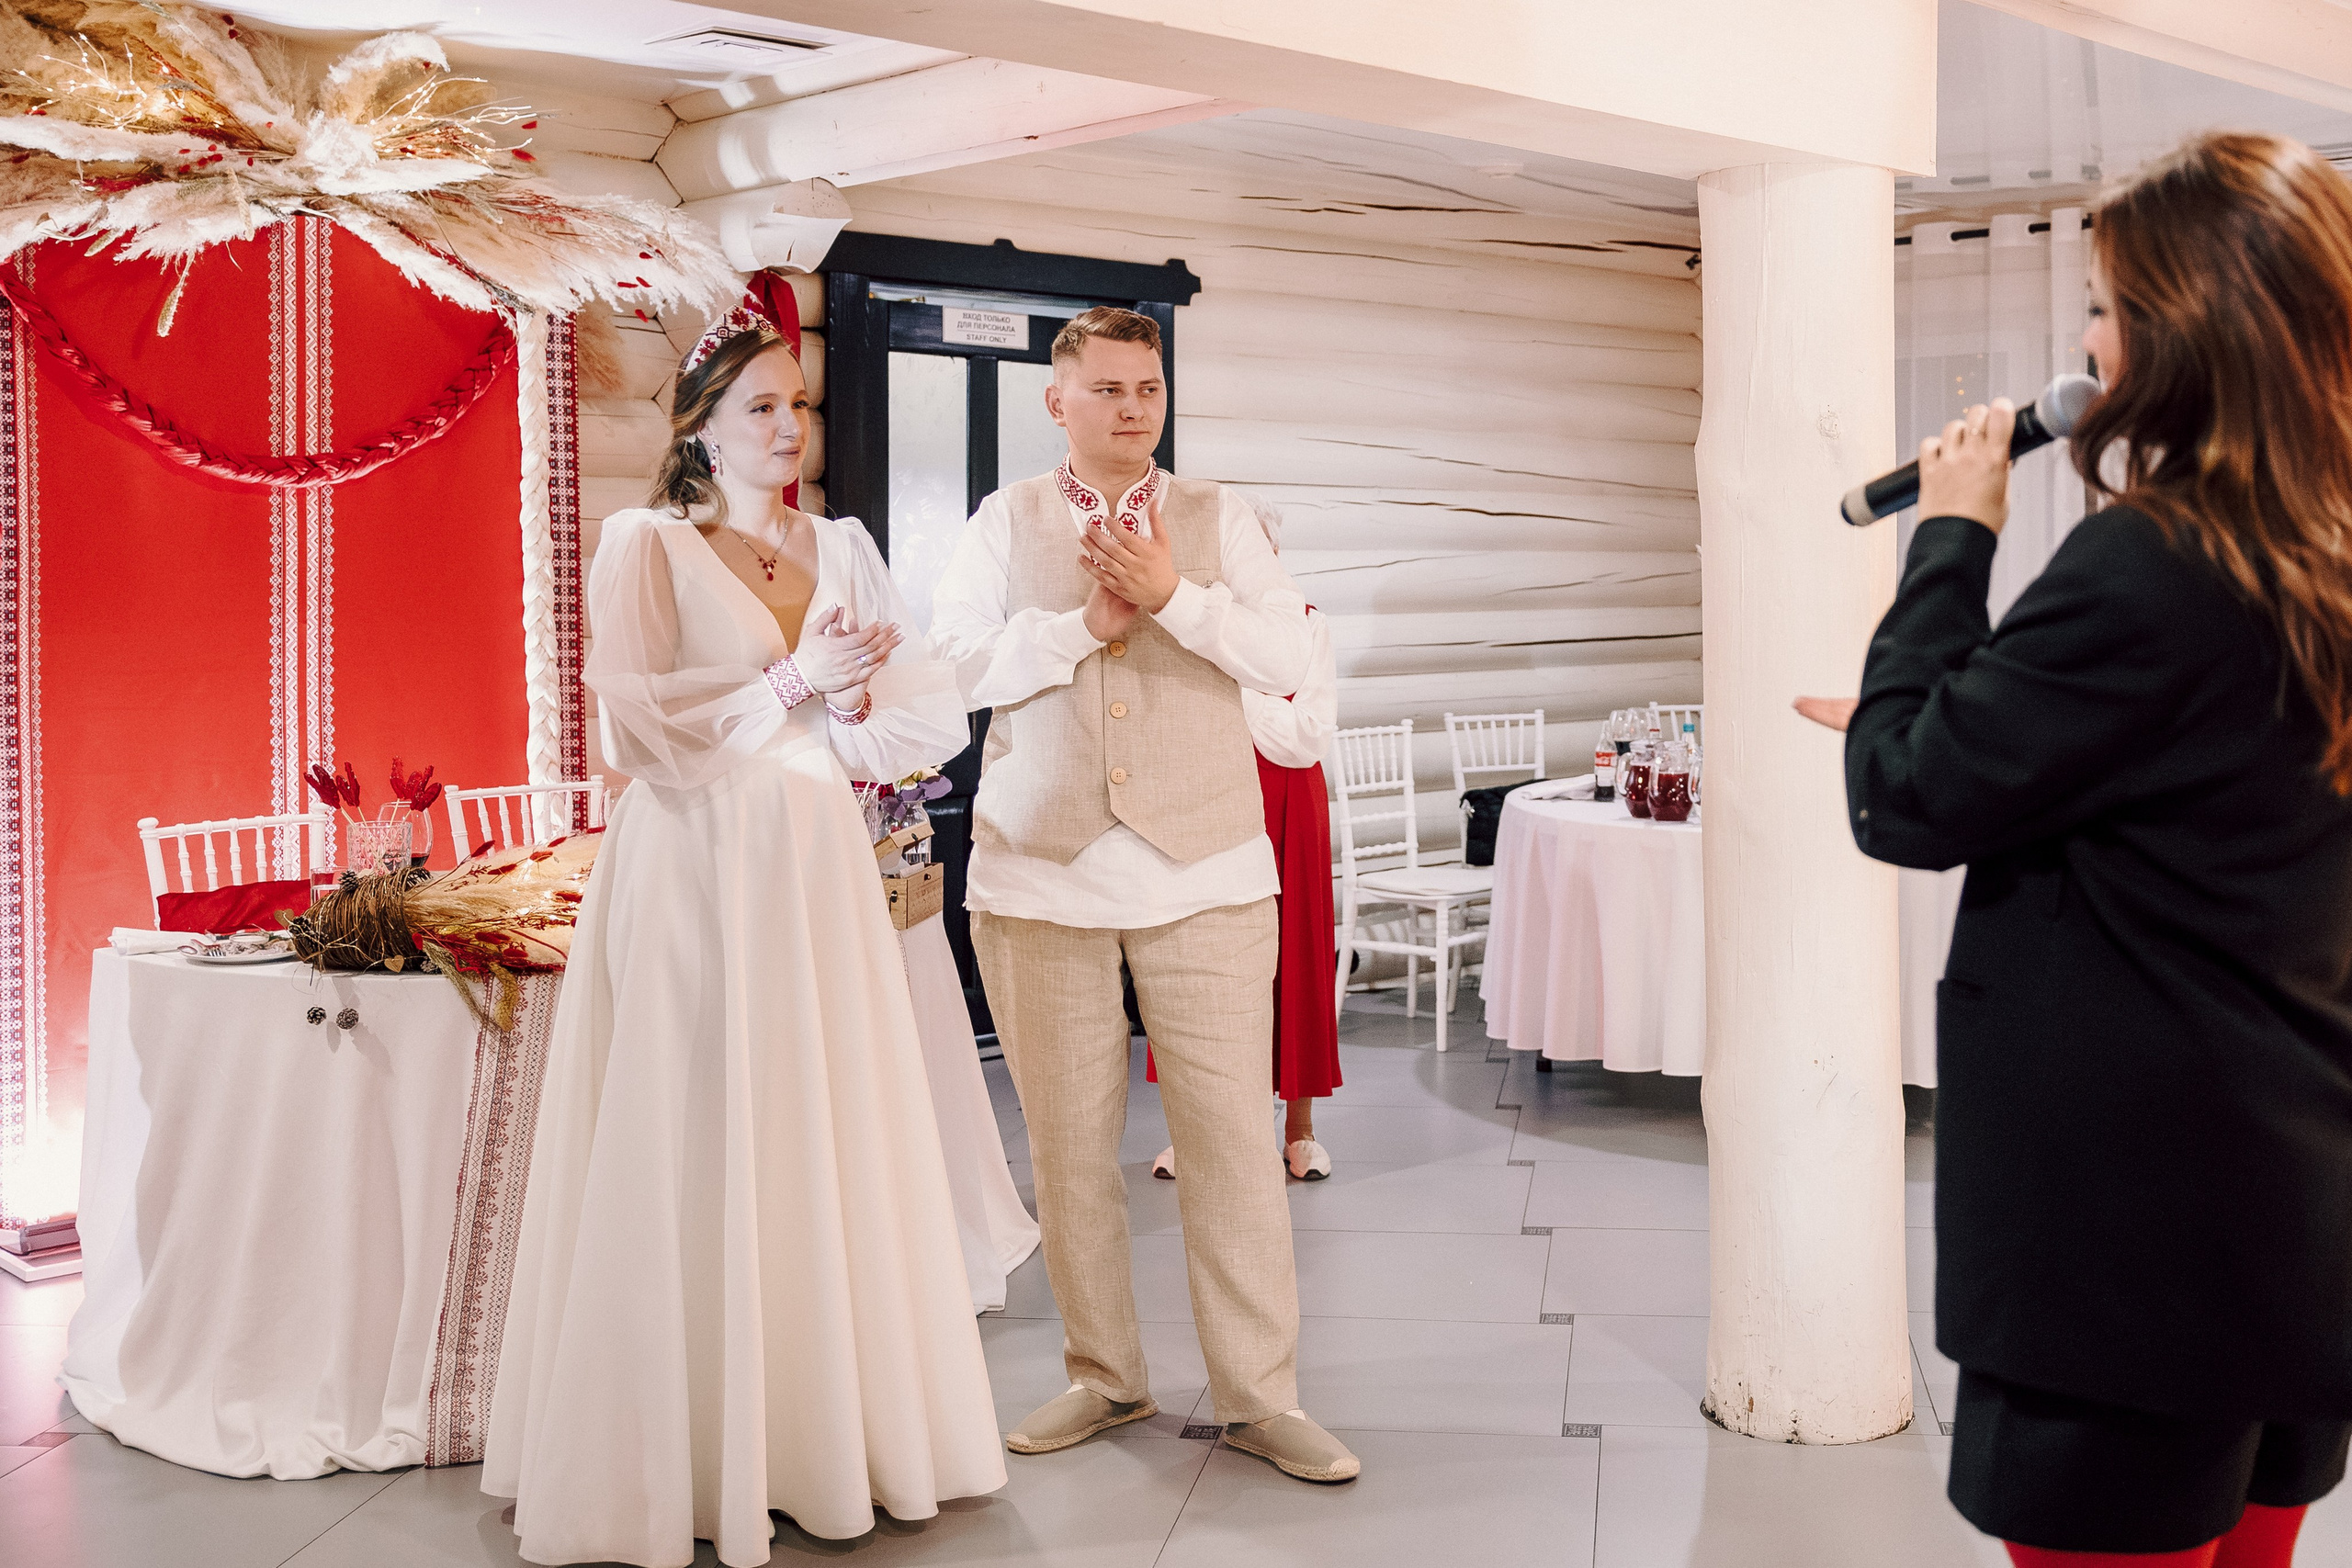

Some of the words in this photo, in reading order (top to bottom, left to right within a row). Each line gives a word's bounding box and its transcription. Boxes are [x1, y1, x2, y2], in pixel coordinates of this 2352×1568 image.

[962, 312, 982, 321] ВХОД
[983, 314, 1011, 323] ТОЛЬКО
[956, 321, 972, 329] ДЛЯ
[973, 321, 1015, 333] ПЕРСОНАЛА
[967, 333, 987, 342] STAFF
[989, 335, 1007, 344] ONLY
